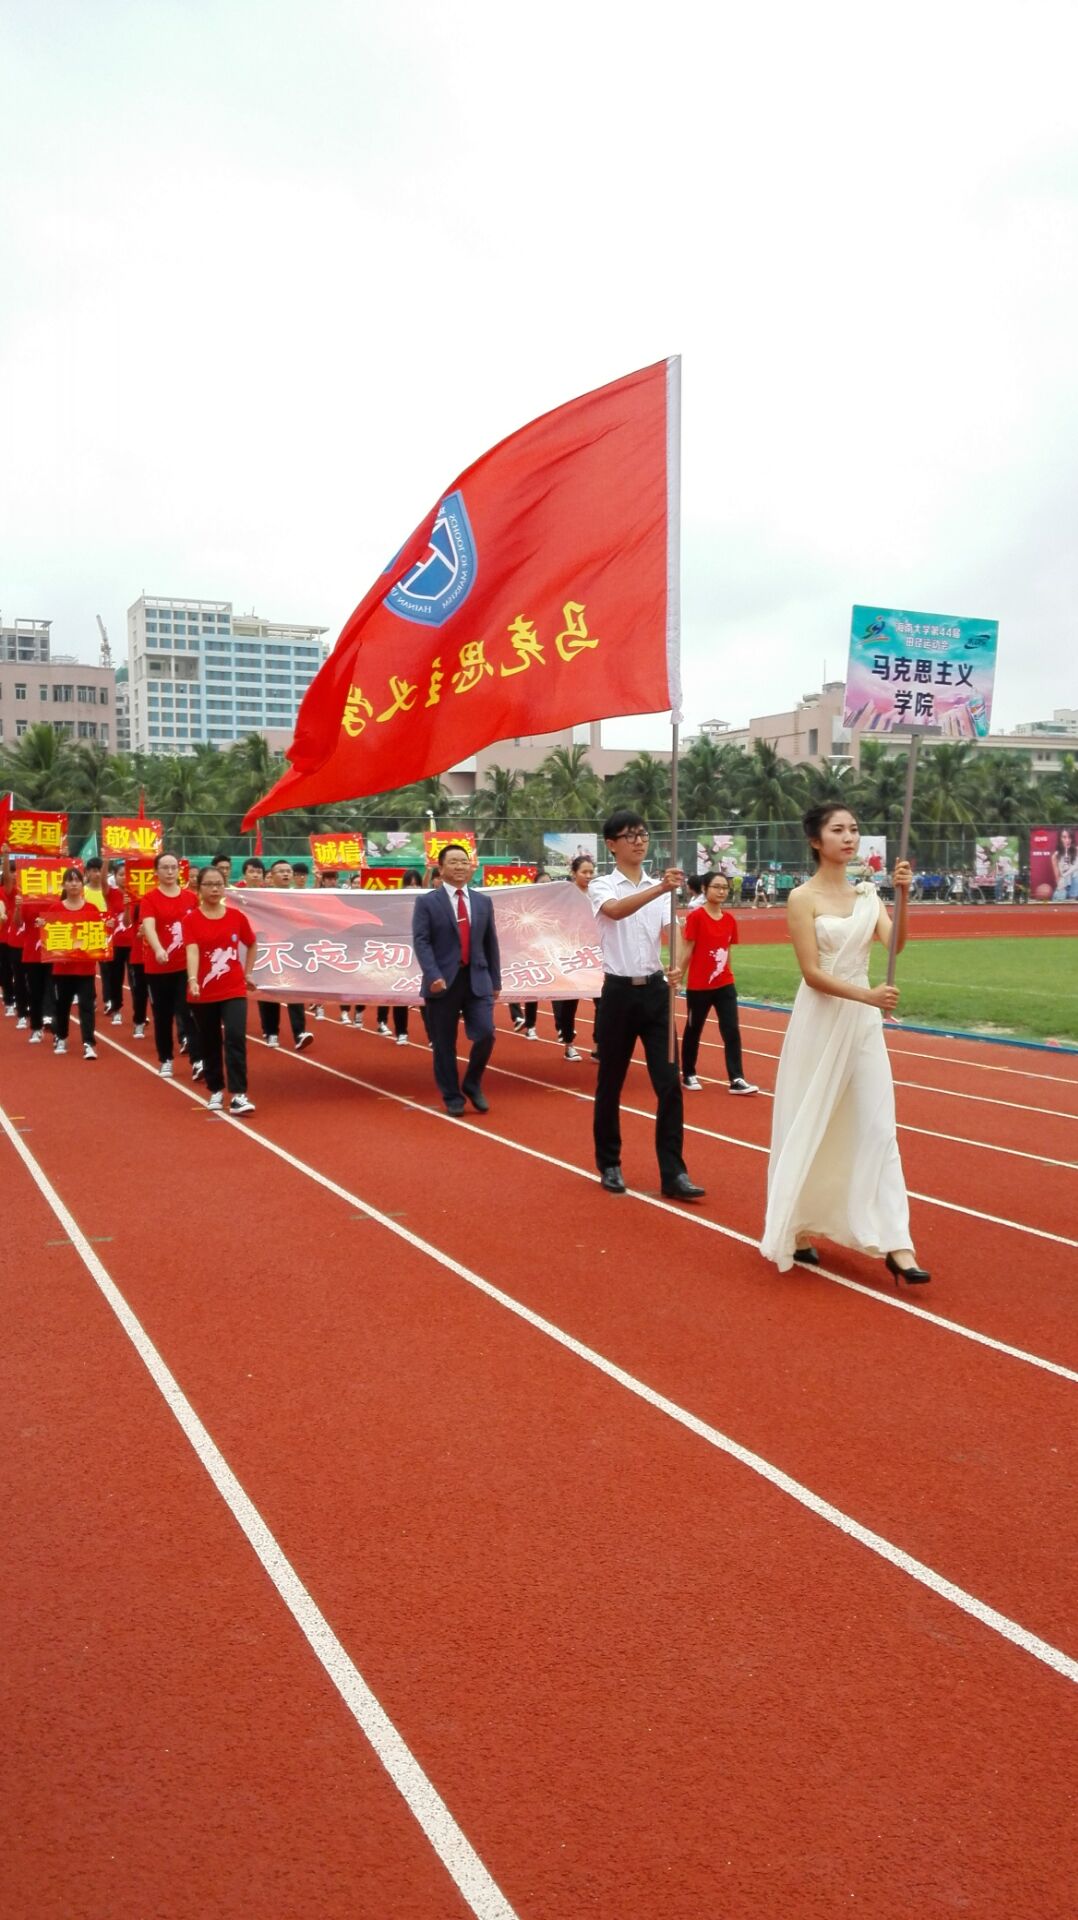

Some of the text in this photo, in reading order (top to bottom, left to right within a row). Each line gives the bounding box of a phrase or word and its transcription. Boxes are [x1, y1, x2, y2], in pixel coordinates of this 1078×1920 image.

[872, 655, 973, 688] 马克思主义
[894, 690, 934, 717] 学院
[9, 819, 62, 847] 爱国
[105, 824, 157, 852] 敬业
[314, 840, 362, 865] 诚信
[44, 921, 108, 951] 富强
